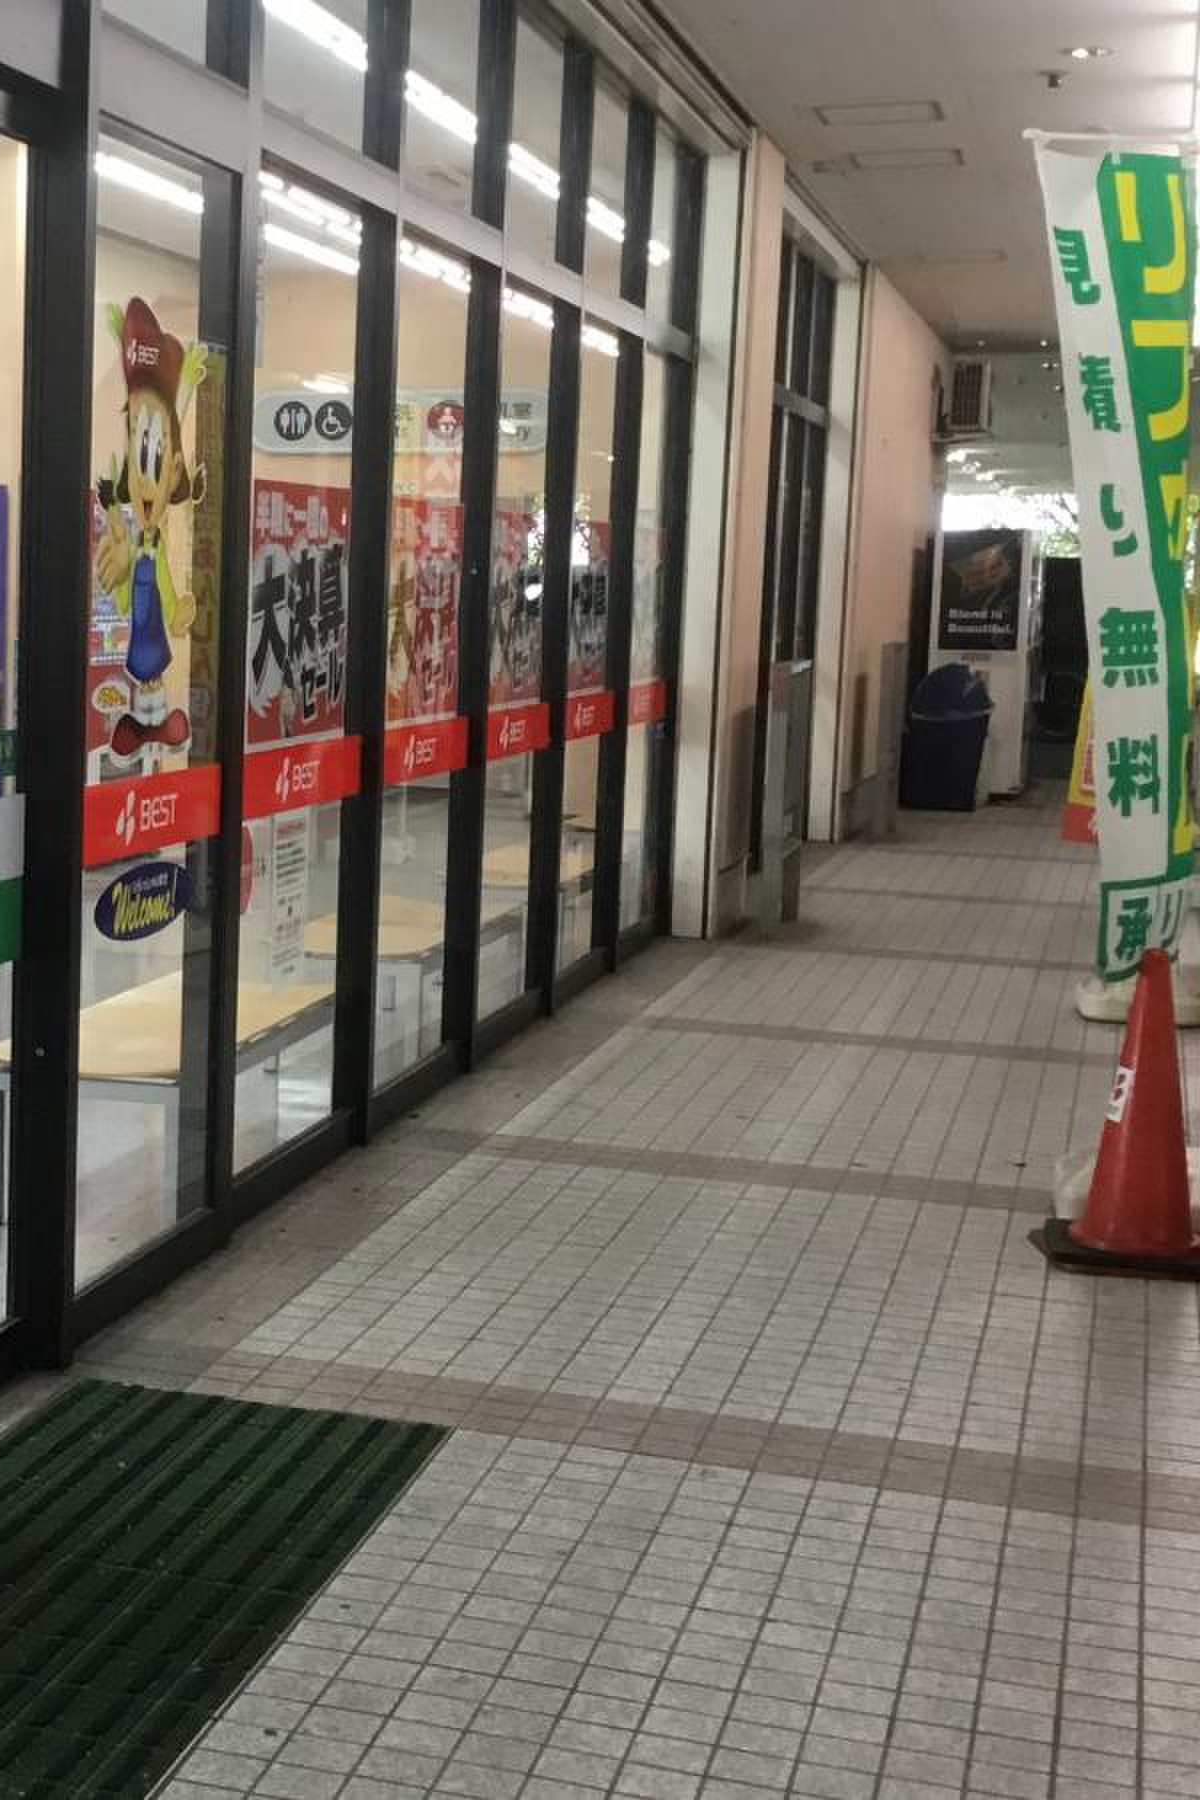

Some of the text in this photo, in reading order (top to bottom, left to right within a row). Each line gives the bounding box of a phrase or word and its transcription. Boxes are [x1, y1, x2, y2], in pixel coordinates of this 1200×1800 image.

[137, 345, 161, 366] BEST
[415, 737, 438, 765] BEST
[291, 759, 321, 791] BEST
[140, 793, 179, 832] BEST
[113, 868, 178, 936] Welcome!
